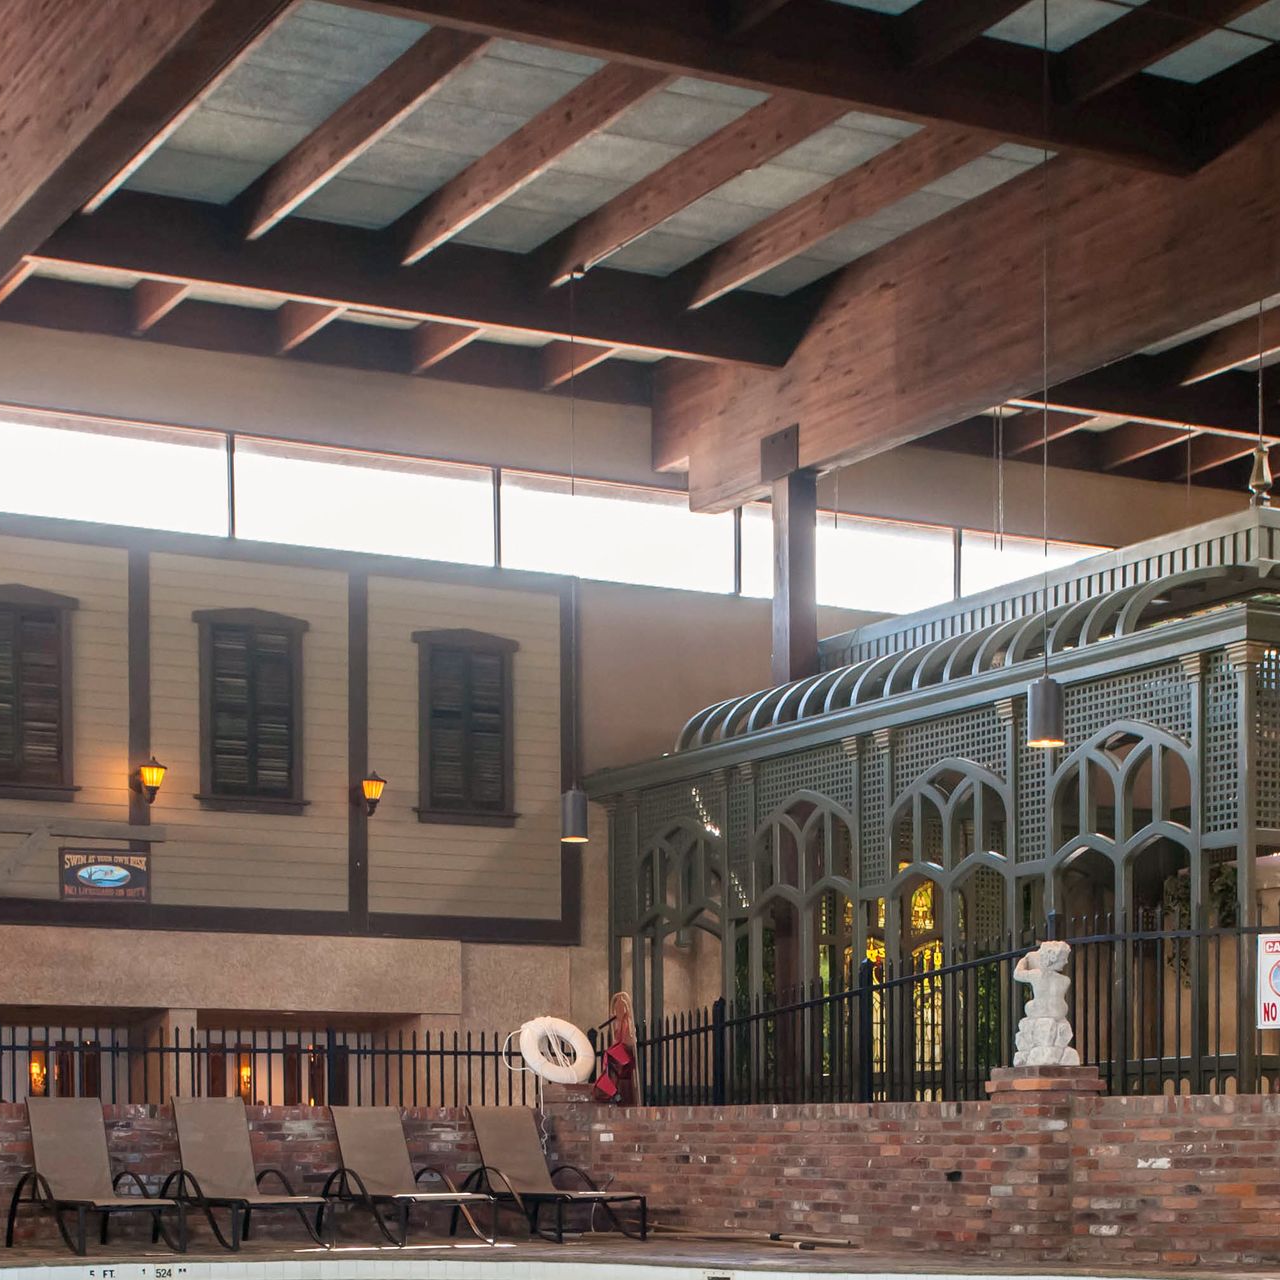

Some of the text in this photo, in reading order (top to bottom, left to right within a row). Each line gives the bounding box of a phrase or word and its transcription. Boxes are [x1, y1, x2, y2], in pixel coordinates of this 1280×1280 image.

[64, 854, 87, 869] SWIM
[88, 855, 95, 863] AT
[130, 855, 146, 871] RISK
[1263, 1002, 1277, 1021] NO
[155, 1268, 172, 1278] 524
